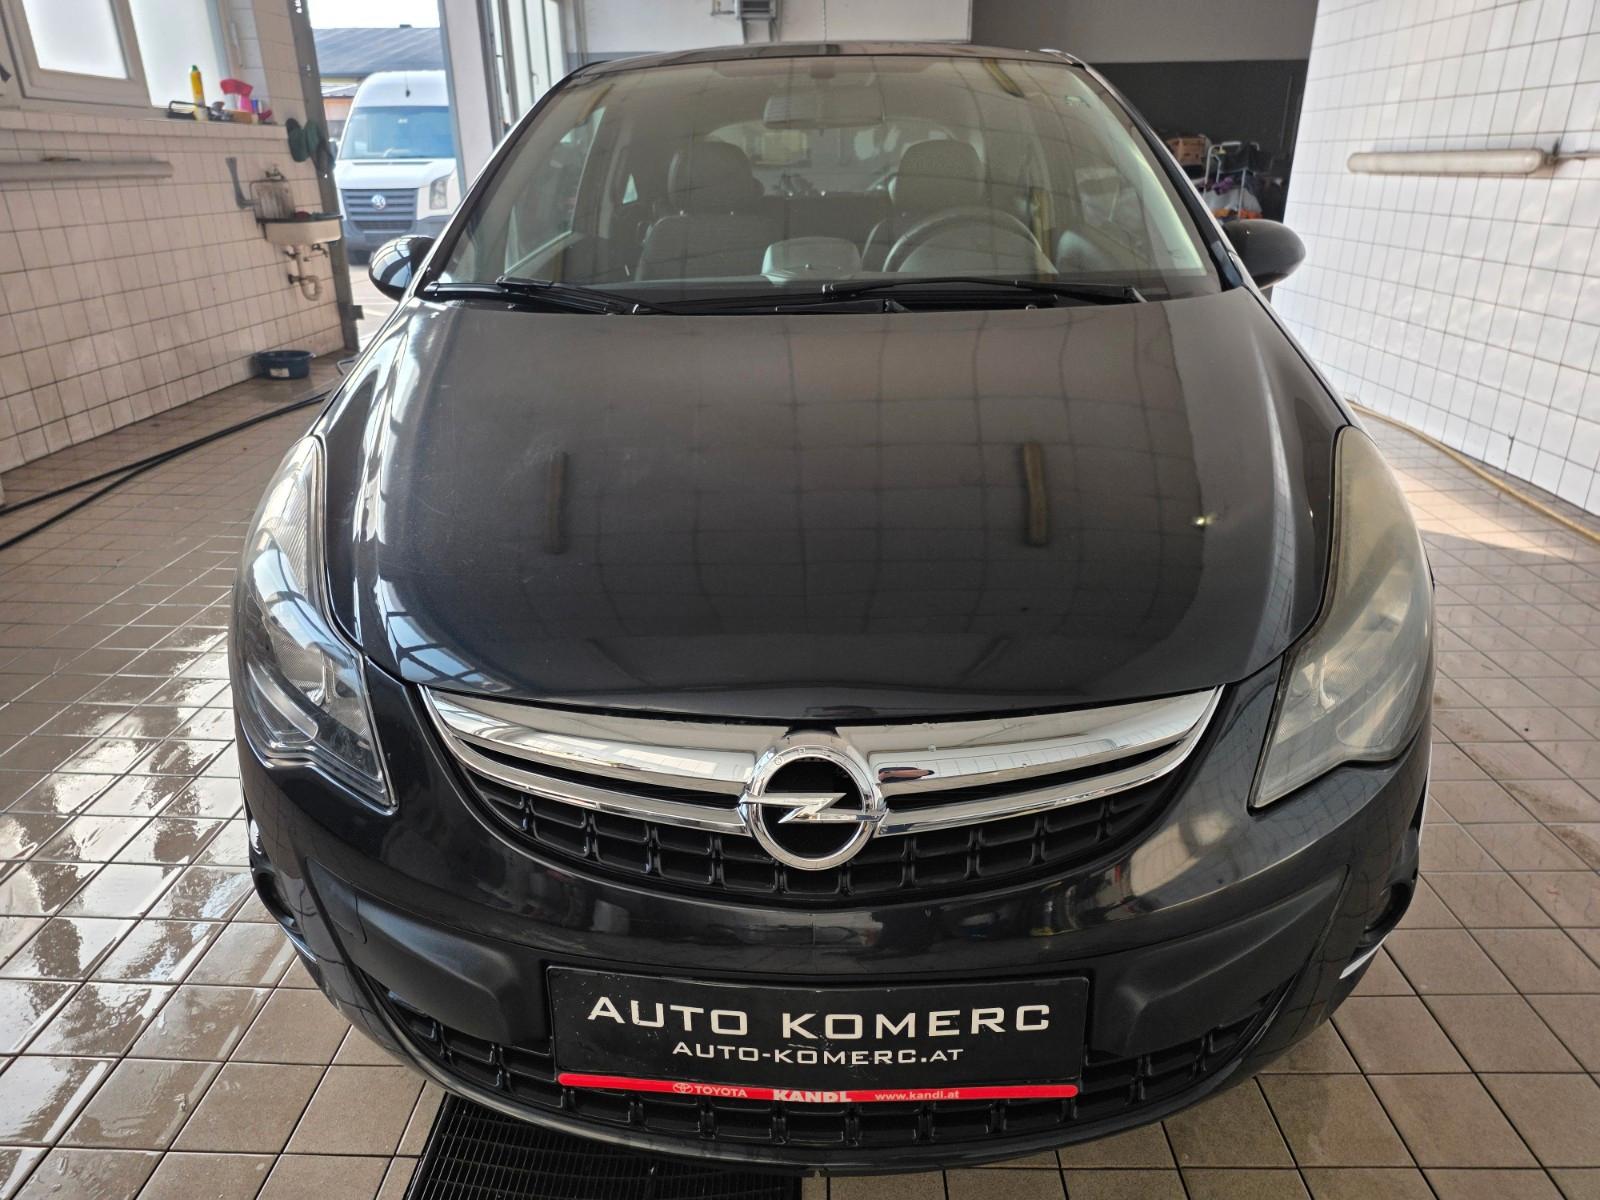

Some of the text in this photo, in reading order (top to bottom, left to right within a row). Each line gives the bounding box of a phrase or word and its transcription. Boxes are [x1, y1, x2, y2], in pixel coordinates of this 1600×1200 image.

[587, 996, 1050, 1040] AUTO KOMERC
[671, 1041, 964, 1065] AUTO-KOMERC.AT
[695, 1085, 960, 1103] TOYOTA KANDL www.kandl.at
